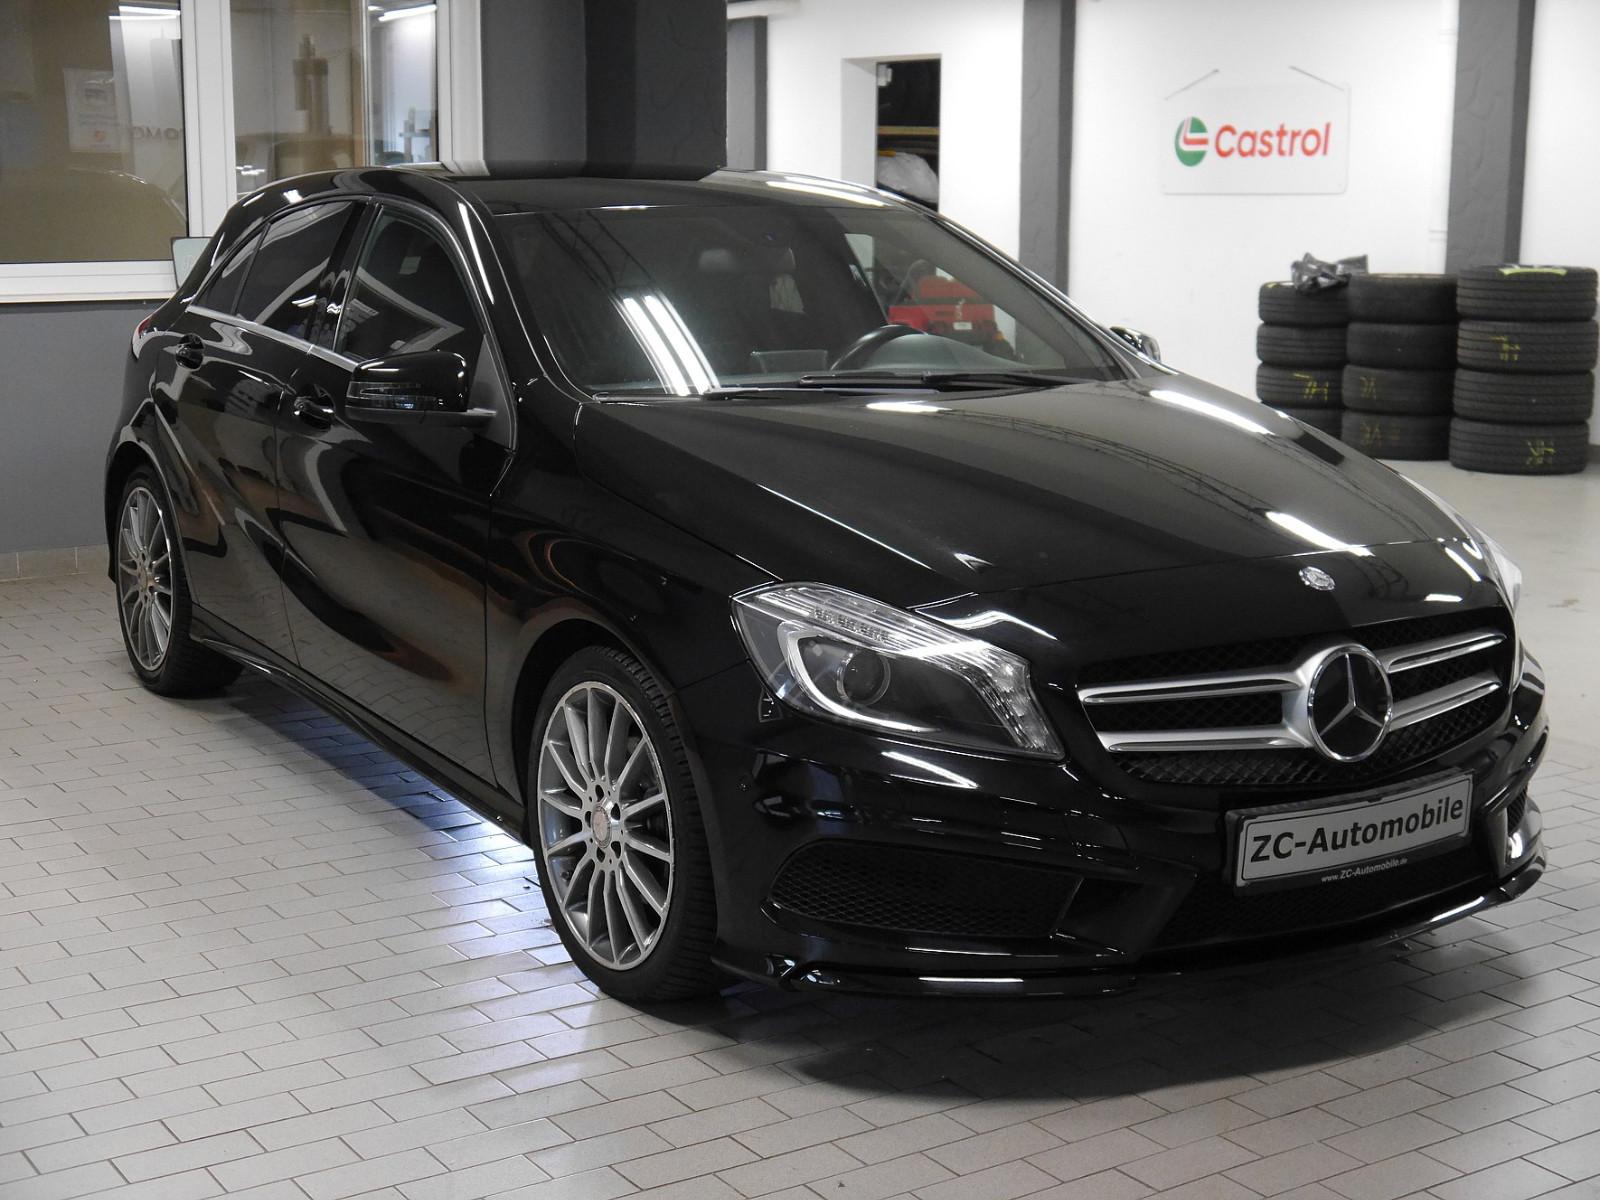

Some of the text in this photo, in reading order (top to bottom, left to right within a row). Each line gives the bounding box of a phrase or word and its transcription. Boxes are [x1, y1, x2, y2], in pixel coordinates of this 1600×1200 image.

[1215, 122, 1331, 158] Castrol
[1251, 797, 1464, 863] ZC-Automobile
[1321, 858, 1409, 882] www.ZC-Automobile.de
